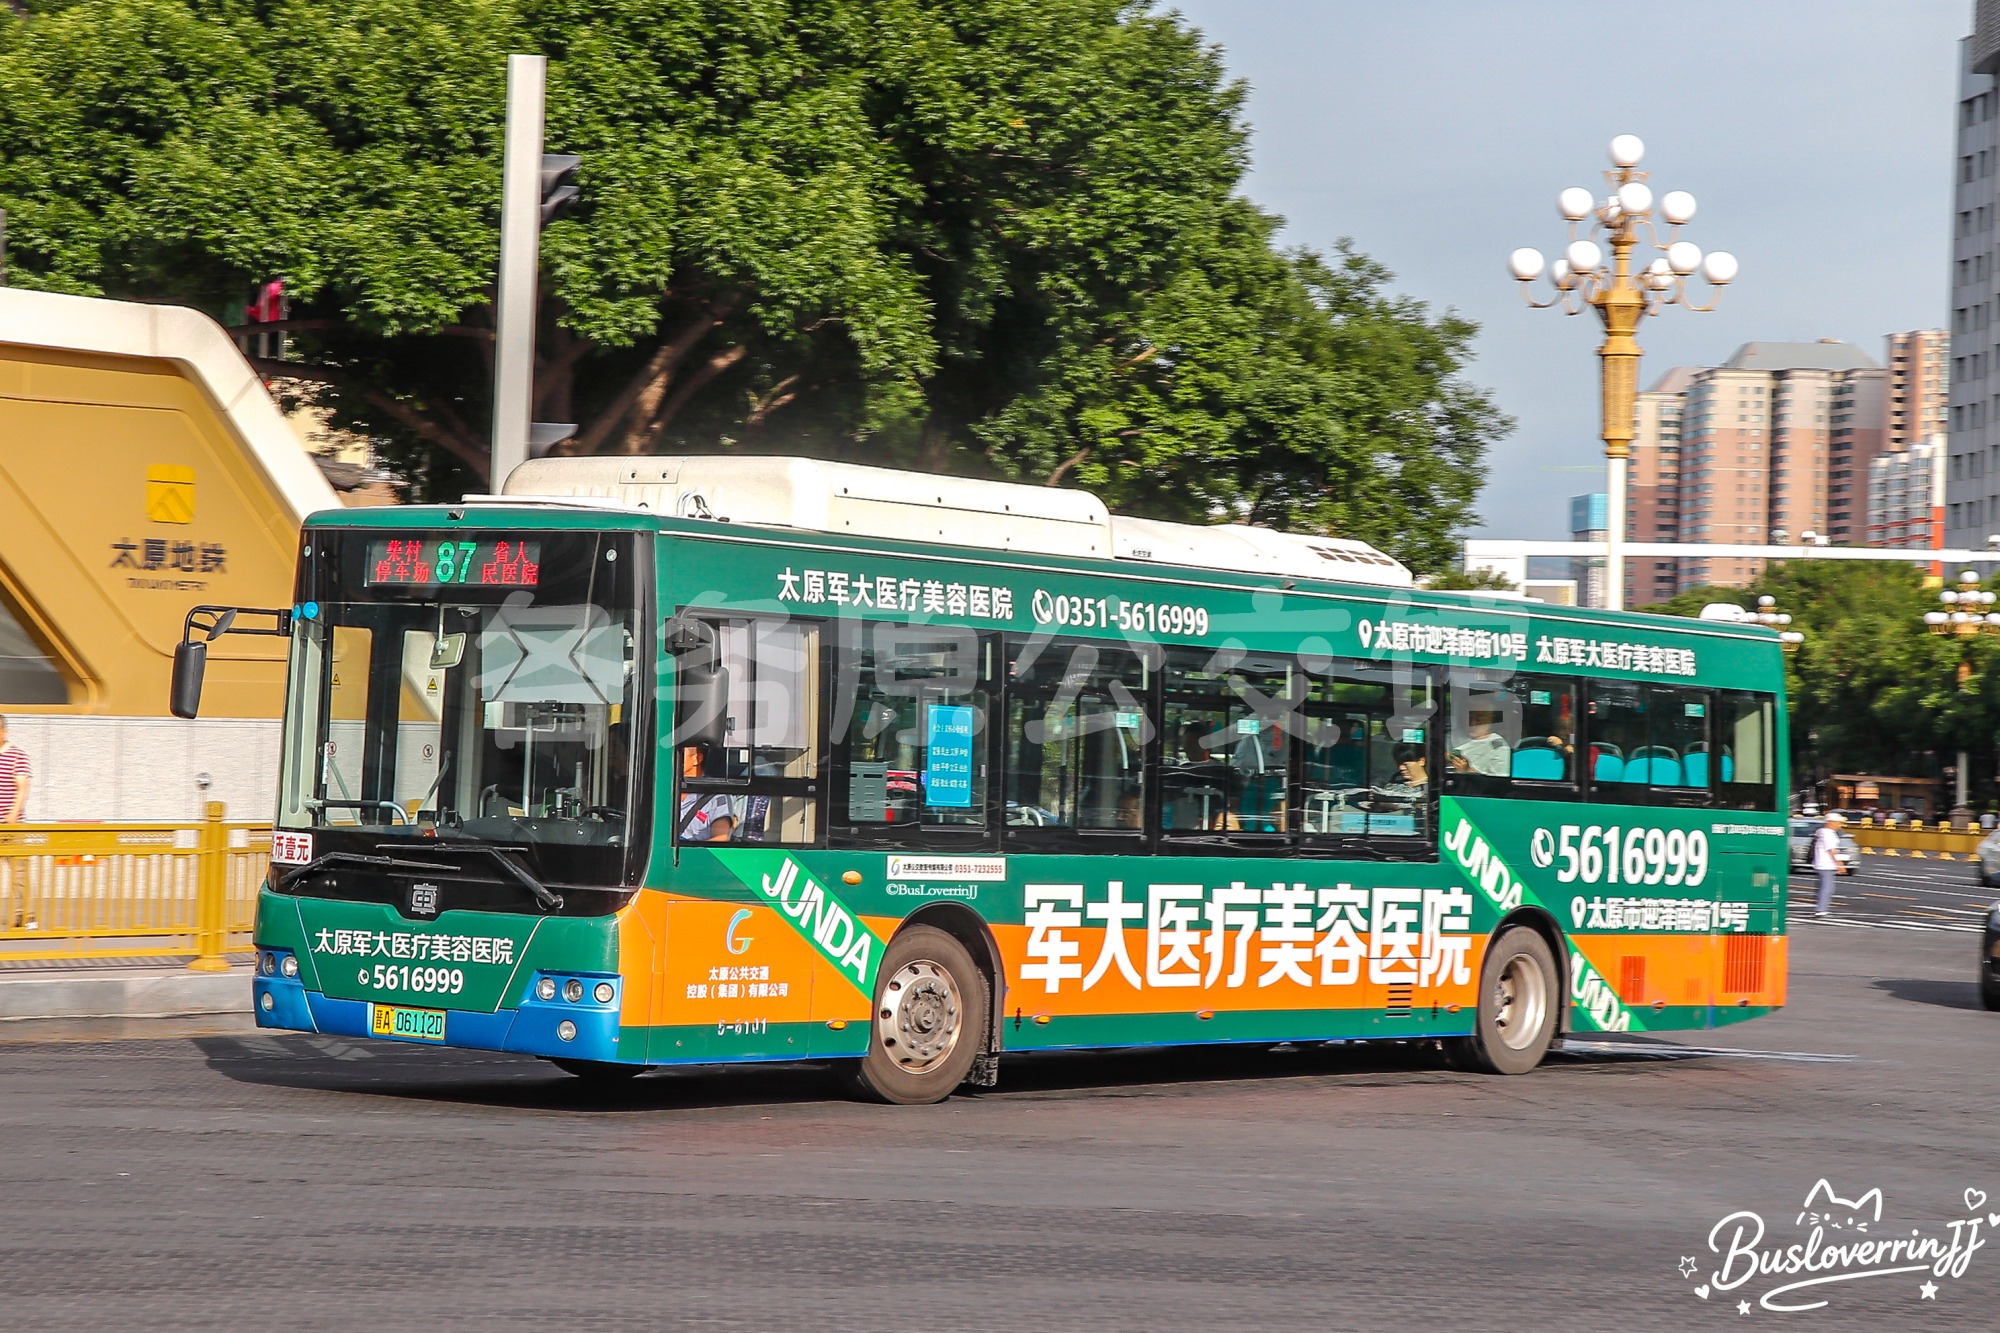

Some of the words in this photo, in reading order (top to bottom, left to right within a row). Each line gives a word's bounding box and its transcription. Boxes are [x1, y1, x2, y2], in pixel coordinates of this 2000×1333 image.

[375, 561, 430, 582] 停车场
[435, 541, 477, 583] 87
[493, 541, 529, 563] 省人
[481, 563, 540, 585] 民医院
[777, 566, 1014, 620] 太原军大医疗美容医院
[1054, 597, 1209, 637] 0351-5616999
[1373, 620, 1528, 662] 太原市迎泽南街19号
[1535, 635, 1697, 677] 太原军大医疗美容医院
[1444, 818, 1523, 912] JUNDA
[1556, 824, 1709, 887] 5616999
[762, 857, 872, 984] JUNDA
[1019, 880, 1473, 994] 军大医疗美容医院
[314, 927, 514, 965] 太原军大医疗美容医院
[373, 964, 464, 994] 5616999
[708, 966, 770, 981] 太原公共交通
